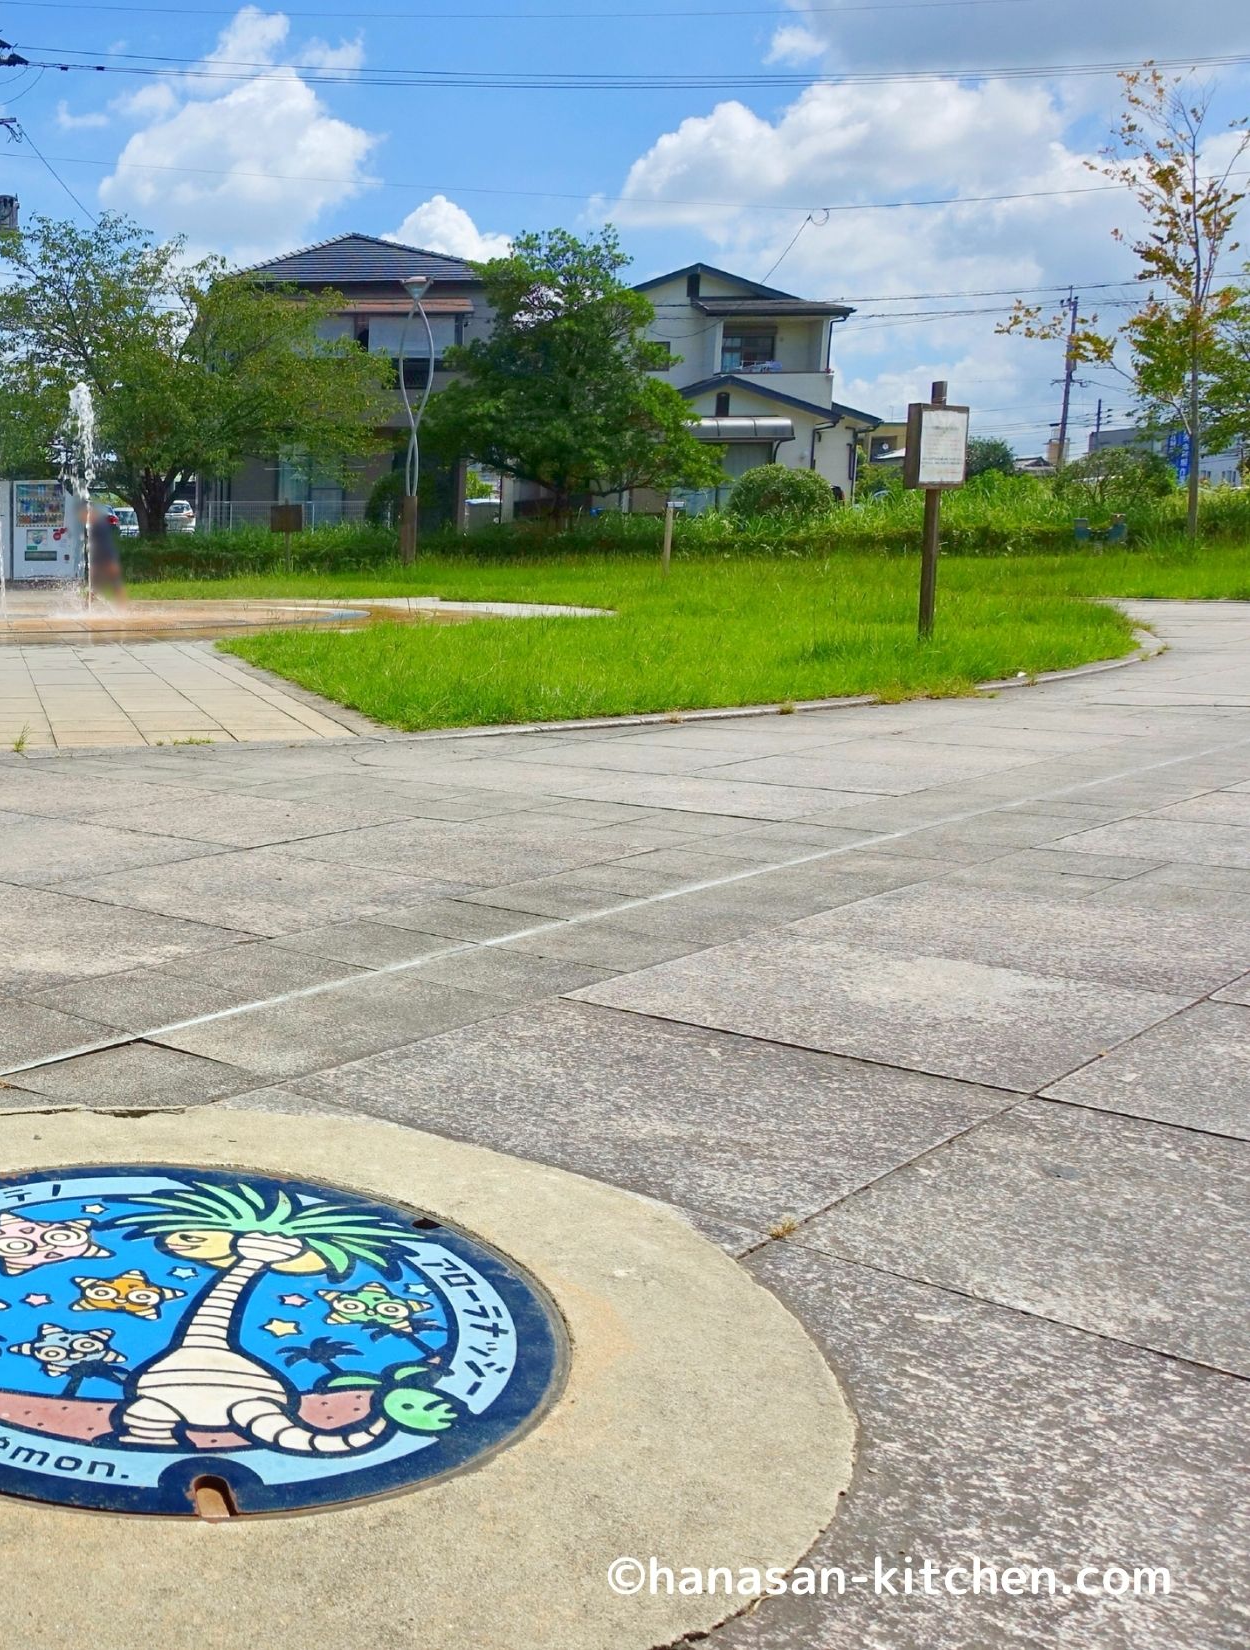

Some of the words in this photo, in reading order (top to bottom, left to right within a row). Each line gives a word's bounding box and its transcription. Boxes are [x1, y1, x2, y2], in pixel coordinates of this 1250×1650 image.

[421, 1257, 510, 1397] アローラナッシー
